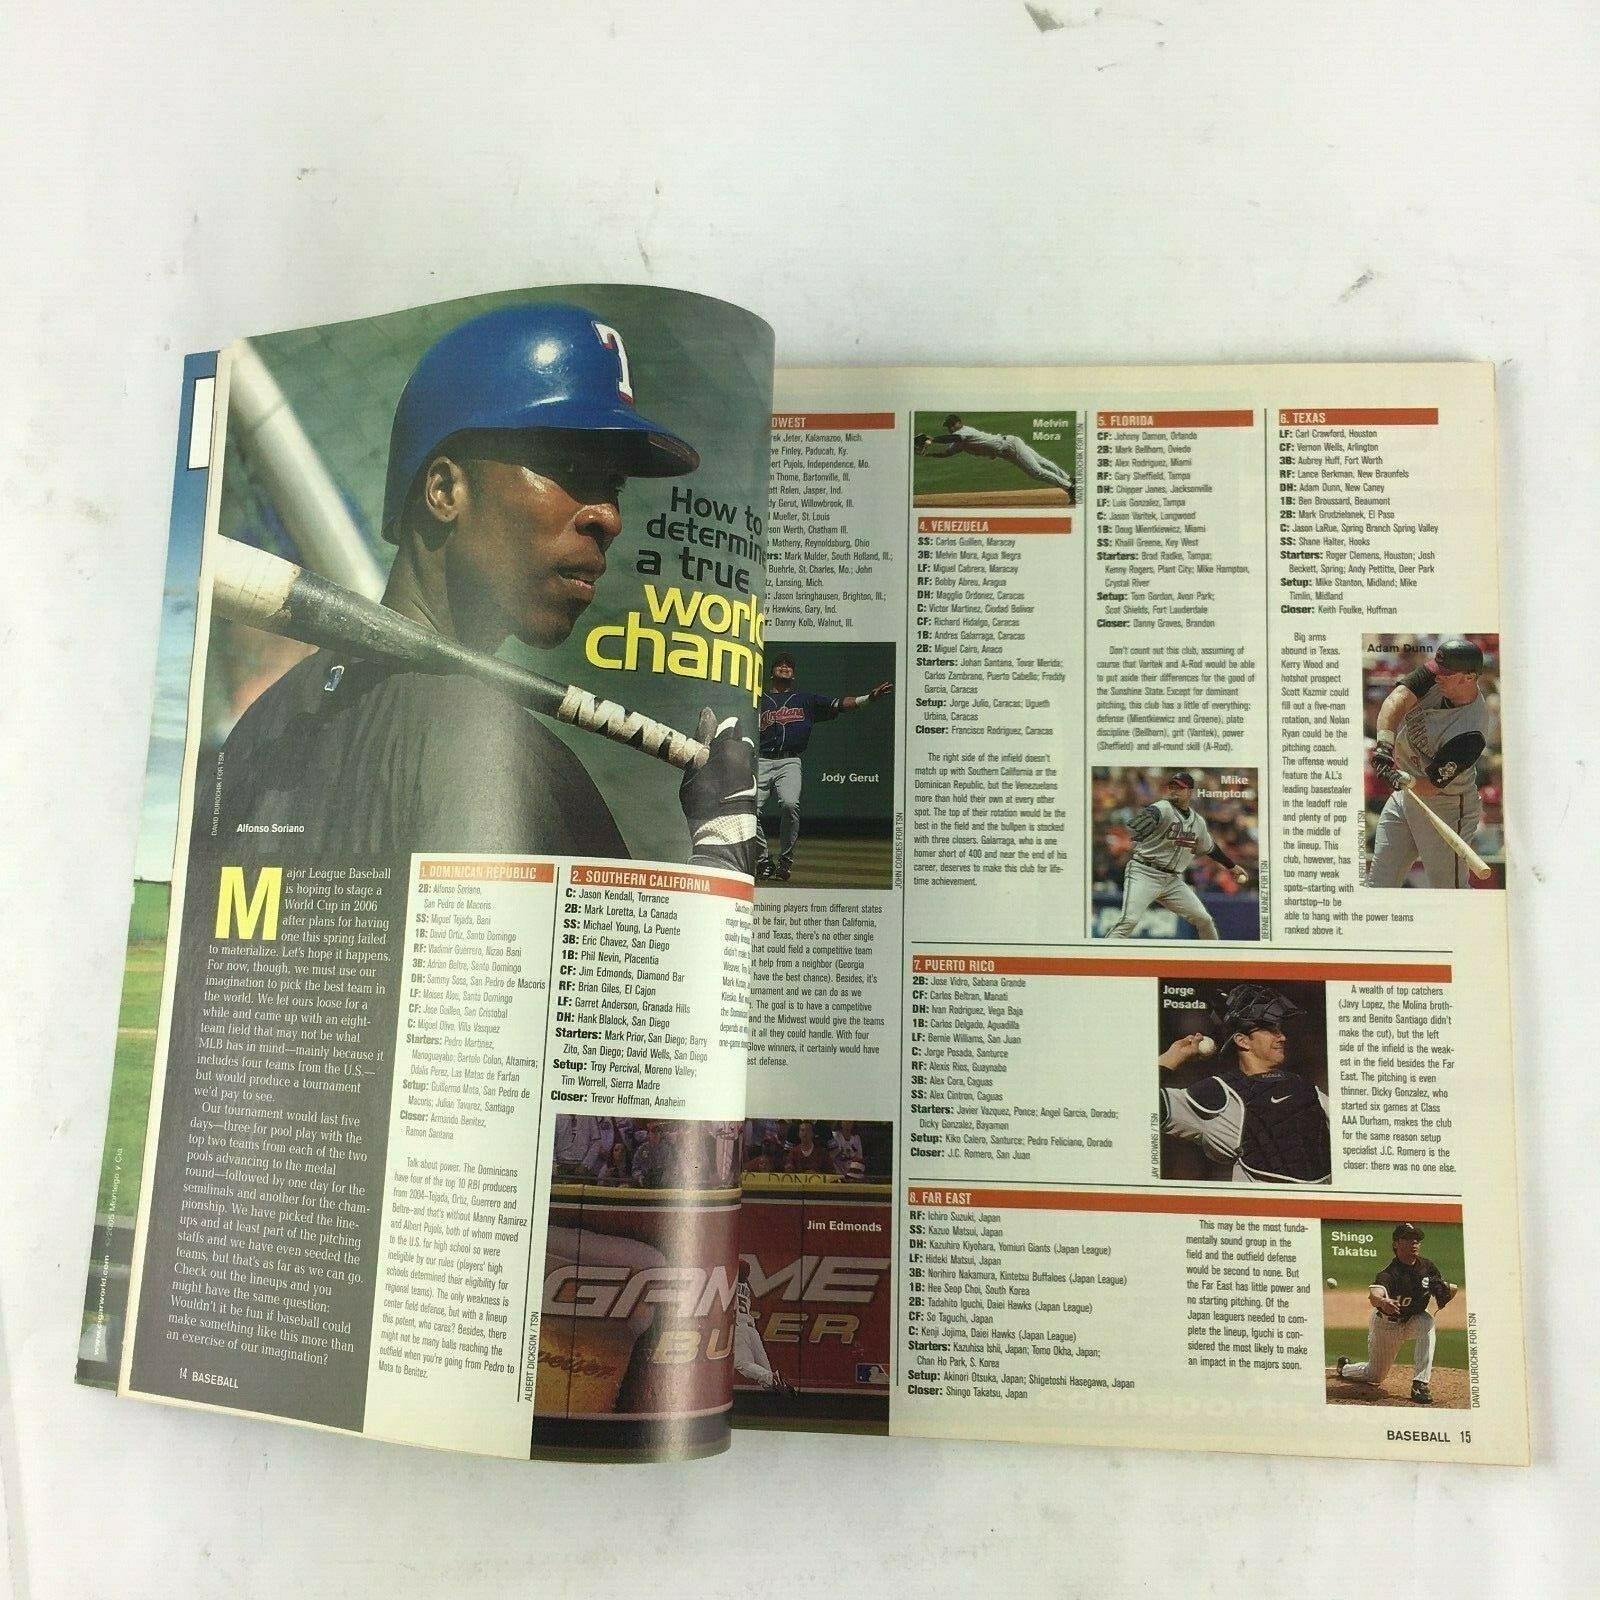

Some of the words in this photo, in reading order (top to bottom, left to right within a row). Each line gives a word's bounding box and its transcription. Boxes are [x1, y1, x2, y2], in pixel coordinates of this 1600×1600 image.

[1033, 418, 1069, 429] Melvin
[1110, 416, 1154, 426] FLORIDA
[1281, 413, 1288, 423] 6.
[1293, 413, 1325, 423] TEXAS
[783, 433, 803, 443] Jeter,
[806, 433, 843, 444] Kalamazoo,
[845, 433, 863, 442] Mich.
[1033, 432, 1061, 441] Mora
[671, 486, 737, 524] How
[746, 506, 763, 536] to
[920, 522, 928, 532] 4.
[932, 521, 989, 532] VENEZUELA
[636, 549, 661, 576] a
[679, 547, 750, 594] true
[1132, 578, 1149, 587] River
[1281, 605, 1315, 614] Closer:
[1318, 606, 1336, 615] Keith
[1339, 606, 1363, 615] Foulke,
[1367, 606, 1397, 614] Huffman
[775, 618, 796, 627] Danny
[799, 618, 816, 628] Kolb,
[818, 619, 843, 628] Walnut,
[1367, 643, 1400, 652] Adam
[1403, 644, 1433, 652] Dunn
[915, 725, 949, 734] Closer:
[952, 726, 984, 735] Francisco
[987, 726, 1022, 736] Rodriguez,
[1026, 727, 1053, 735] Caracas
[822, 772, 845, 784] Jody
[849, 773, 879, 782] Gerut
[1220, 776, 1248, 784] Mike
[1197, 789, 1248, 800] Hampton
[237, 824, 269, 832] Alfonso
[271, 824, 304, 832] Soriano
[309, 868, 346, 881] League
[349, 868, 391, 879] Baseball
[430, 866, 483, 878] DOMINICAN
[487, 867, 536, 879] REPUBLIC
[572, 872, 581, 882] 2.
[586, 871, 646, 885] SOUTHERN
[650, 875, 710, 892] CALIFORNIA
[285, 885, 294, 894] is
[297, 884, 331, 896] hoping
[334, 885, 343, 895] to
[346, 886, 373, 897] stage
[566, 888, 576, 898] C:
[579, 889, 601, 899] Jason
[605, 890, 635, 902] Kendall,
[638, 892, 669, 904] Torrance
[284, 899, 313, 910] World
[317, 900, 338, 913] Cup
[341, 901, 350, 910] in
[354, 901, 378, 911] 2006
[565, 904, 581, 914] 2B:
[585, 905, 603, 915] Mark
[607, 906, 635, 918] Loretta,
[639, 908, 647, 917] La
[651, 909, 677, 920] Canada
[282, 916, 304, 926] after
[309, 916, 335, 928] plans
[338, 917, 352, 926] for
[355, 917, 389, 931] having
[564, 919, 580, 929] SS:
[583, 920, 612, 931] Michael
[616, 921, 640, 934] Young,
[644, 923, 652, 933] La
[656, 924, 680, 935] Puente
[1285, 926, 1309, 936] ranked
[1312, 926, 1333, 935] above
[302, 932, 320, 942] this
[323, 935, 355, 946] spring
[357, 934, 386, 944] failed
[562, 935, 579, 945] 3B:
[582, 936, 597, 945] Eric
[600, 936, 628, 948] Chavez,
[632, 938, 645, 948] San
[650, 940, 669, 950] Diego
[914, 960, 921, 970] 7.
[925, 959, 966, 972] PUERTO
[970, 961, 995, 972] RICO
[1163, 986, 1194, 996] Jorge
[1351, 986, 1356, 994] A
[1359, 986, 1383, 995] wealth
[1386, 987, 1394, 995] of
[1396, 987, 1408, 997] top
[1411, 987, 1443, 996] catchers
[1164, 999, 1206, 1010] Posada
[1344, 1161, 1368, 1171] closer:
[1371, 1161, 1390, 1172] there
[1393, 1162, 1408, 1172] was
[1411, 1163, 1420, 1172] no
[1423, 1164, 1436, 1172] one
[1439, 1164, 1456, 1174] else.
[909, 1192, 918, 1203] 8.
[922, 1192, 942, 1204] FAR
[946, 1193, 972, 1204] EAST
[807, 1220, 825, 1230] Jim
[829, 1221, 882, 1232] Edmonds
[1332, 1232, 1373, 1243] Shingo
[1332, 1246, 1377, 1257] Takatsu
[1469, 1330, 1477, 1344] FOR
[166, 1330, 179, 1340] an
[182, 1332, 224, 1348] exercise
[228, 1337, 238, 1350] of
[241, 1341, 259, 1353] our
[262, 1344, 328, 1365] imagination?
[527, 1335, 536, 1369] DICKSON
[1470, 1346, 1479, 1383] DUROCHIK
[179, 1368, 187, 1379] 14
[192, 1372, 238, 1389] BASEBALL
[525, 1371, 533, 1402] ALBERT
[908, 1385, 943, 1396] Closer:
[946, 1386, 970, 1398] Shingo
[973, 1387, 1002, 1398] Takatsu,
[1005, 1389, 1027, 1399] Japan
[1472, 1386, 1480, 1408] DAVID
[1387, 1430, 1450, 1442] BASEBALL
[1460, 1431, 1471, 1444] 15
